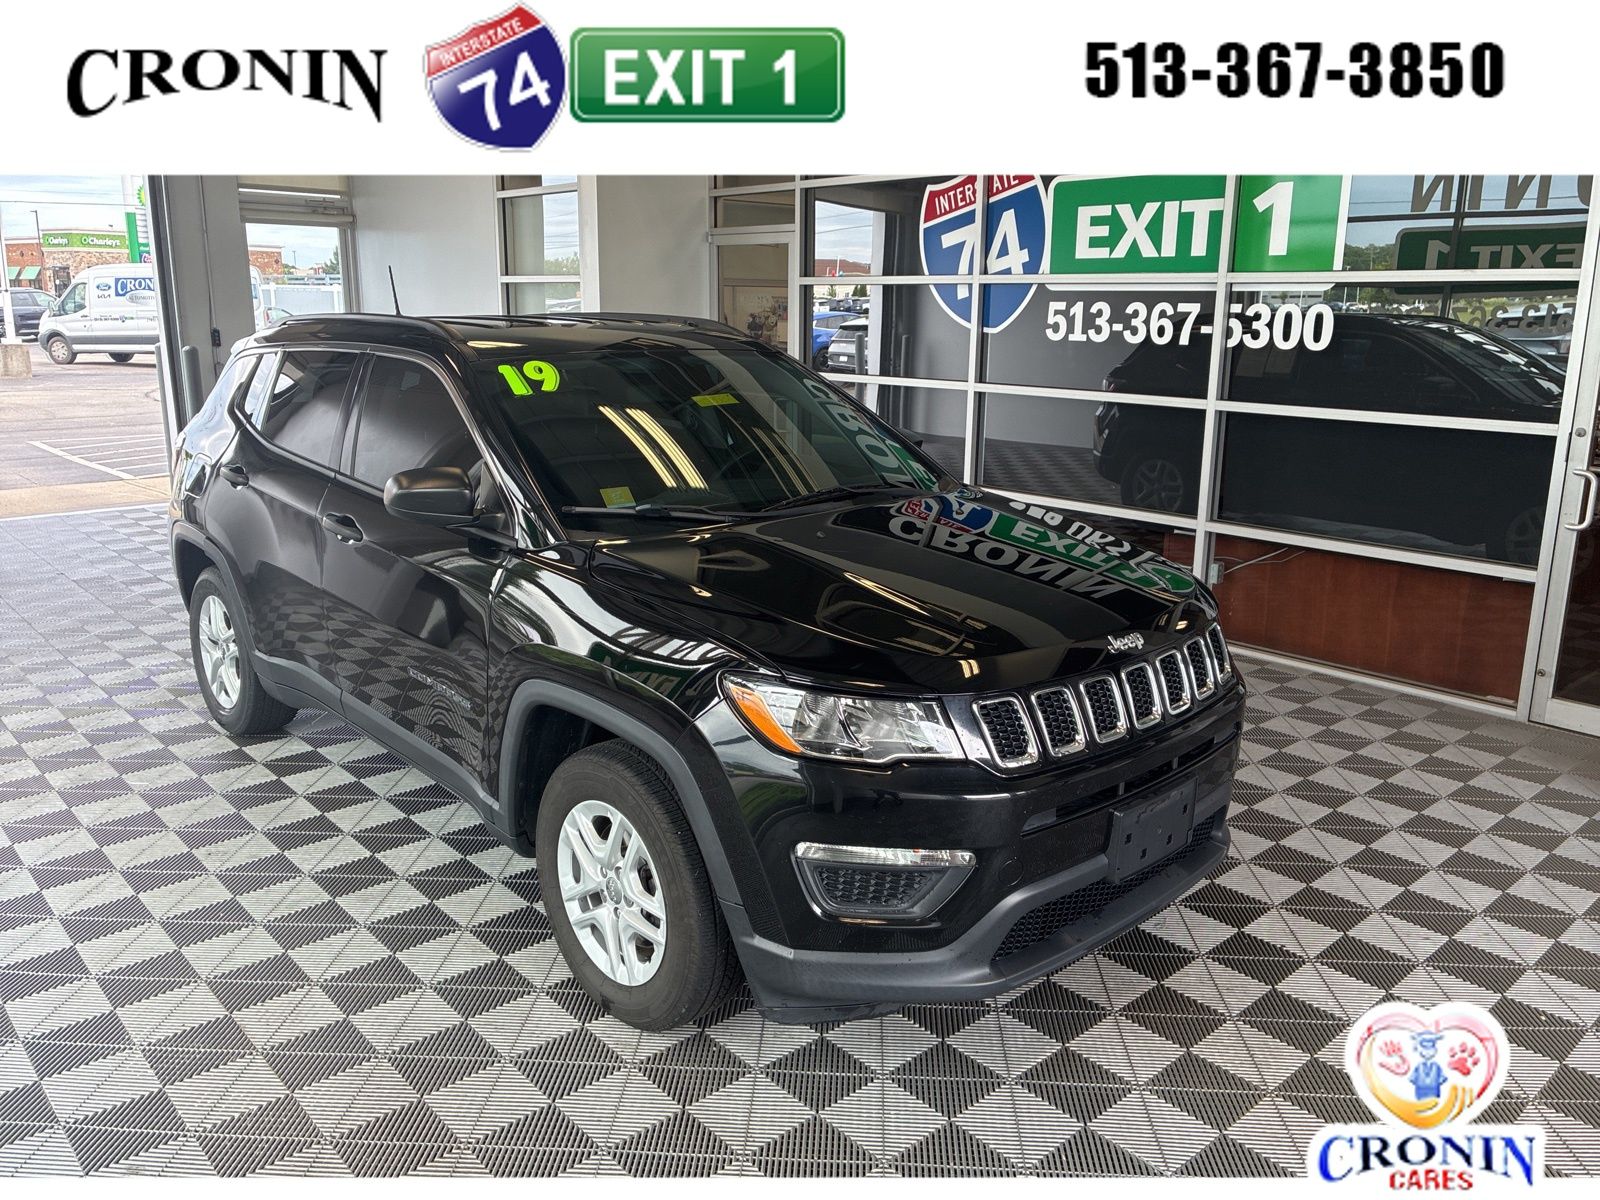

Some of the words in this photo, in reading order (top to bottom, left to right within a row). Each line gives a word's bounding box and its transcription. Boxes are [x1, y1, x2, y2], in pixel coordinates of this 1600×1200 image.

[1075, 199, 1224, 260] EXIT
[1252, 181, 1294, 256] 1
[940, 208, 1030, 300] 74
[1045, 300, 1335, 351] 513-367-5300
[498, 360, 562, 396] 19
[1107, 631, 1146, 654] Jeep
